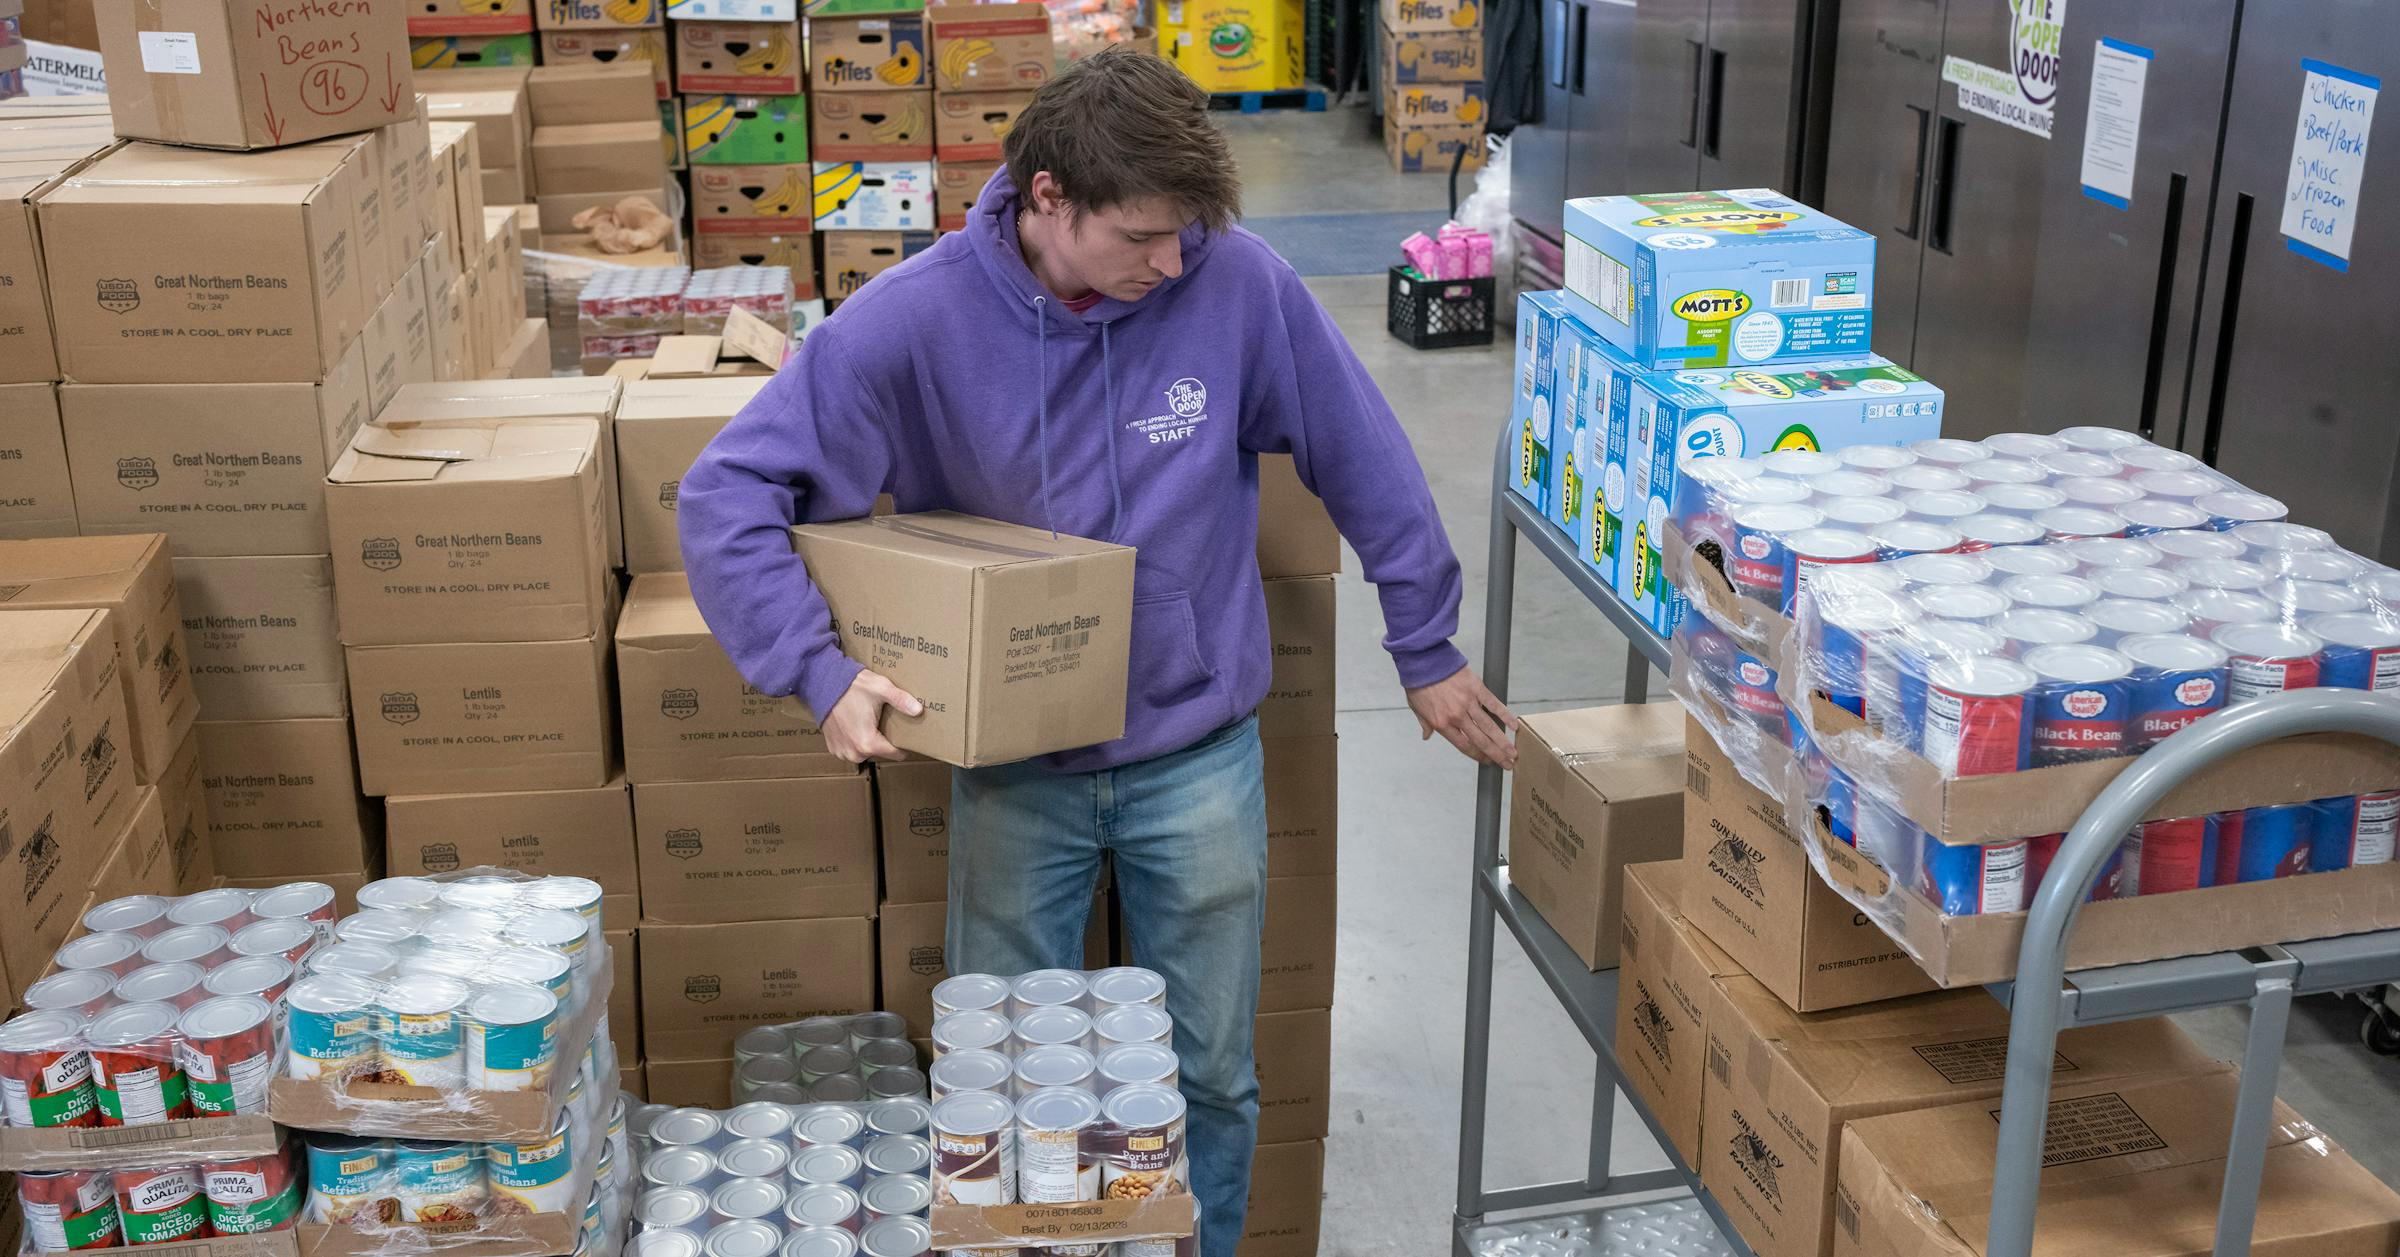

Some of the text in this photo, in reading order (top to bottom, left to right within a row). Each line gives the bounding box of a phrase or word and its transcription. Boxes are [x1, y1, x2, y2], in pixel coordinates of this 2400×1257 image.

[256, 0, 371, 38] Northern
[277, 32, 360, 65] Beans
[2021, 48, 2060, 86] DOOR
[1951, 63, 2017, 96] FRESH APPROACH
[313, 68, 346, 106] 96
[2313, 80, 2366, 116] Chicken
[1971, 92, 2001, 115] ENDING
[2002, 102, 2027, 124] LOCAL
[2305, 181, 2346, 208] Frozen
[2301, 209, 2335, 236] Food
[154, 275, 288, 289] Great Northern Beans
[101, 292, 135, 300] FOOD
[211, 302, 223, 310] 24
[1680, 296, 1744, 314] MOTT'S
[121, 329, 160, 337] STORE
[227, 328, 252, 336] DRY
[256, 328, 293, 336] PLACE
[1175, 383, 1192, 395] THE
[1181, 389, 1204, 402] OPEN
[1177, 400, 1202, 412] DOOR
[1130, 413, 1177, 428] FRESH APPROACH
[1147, 422, 1168, 431] ENDING
[1168, 419, 1187, 428] LOCAL
[1188, 414, 1208, 425] HUNGER
[1148, 425, 1196, 443] STAFF
[172, 452, 302, 466] Great Northern Beans
[139, 504, 178, 513] STORE
[180, 504, 191, 512] IN
[244, 502, 267, 511] DRY
[271, 502, 308, 511] PLACE
[1594, 490, 1604, 560] MOTT'S
[415, 532, 542, 548] Great Northern Beans
[1635, 526, 1646, 595] MOTT'S
[384, 582, 550, 594] STORE IN COOL, DRY PLACE
[205, 614, 297, 629] Northern Beans
[1009, 615, 1101, 642] Great Northern Beans
[853, 621, 949, 658] Great Northern Beans
[887, 648, 904, 660] bags
[1006, 644, 1041, 659] PO# 32547
[1278, 644, 1313, 656] Beans
[243, 663, 306, 673] DRY PLACE
[1004, 661, 1028, 673] Packed
[1046, 664, 1058, 675] ND
[2265, 665, 2284, 673] Facts
[463, 687, 501, 700] Lentils
[2181, 682, 2213, 696] American
[2067, 693, 2101, 707] American
[2183, 691, 2208, 704] Beauty
[2070, 703, 2098, 716] Beauty
[2143, 717, 2189, 732] Black
[403, 733, 564, 746] STORE IN DRY PLACE
[680, 733, 715, 741] STORE
[2035, 727, 2122, 741] Black Beans
[1688, 750, 1711, 772] 24/15 OZ
[225, 774, 314, 788] Northern Beans
[1762, 803, 1775, 819] 22.5
[744, 822, 781, 835] Lentils
[501, 835, 540, 848] Lentils
[1568, 824, 1585, 849] Beans
[1710, 818, 1766, 864] SUN VALLEY
[1987, 849, 2014, 857] Nutrition
[685, 872, 720, 880] STORE
[1711, 896, 1742, 925] PRODUCT OF
[1818, 954, 1890, 973] DISTRIBUTED BY
[762, 968, 797, 981] Lentils
[1636, 979, 1651, 1002] SUN
[1649, 999, 1674, 1033] VALLEY
[1711, 1033, 1732, 1061] 24/15 OZ
[1731, 1109, 1785, 1169] SUN VALLEY
[1781, 1111, 1818, 1154] 22.5 NET
[1130, 1137, 1163, 1149] FINEST
[2113, 1137, 2160, 1152] STORAGE
[1123, 1149, 1170, 1162] Pork and
[343, 1157, 377, 1173] FINEST
[1130, 1159, 1163, 1169] Beans
[147, 1176, 183, 1194] PRIMA
[212, 1176, 248, 1187] PRIMA
[502, 1176, 537, 1187] Beans
[142, 1184, 189, 1206] QUALITA
[210, 1184, 253, 1195] QUALITA
[322, 1183, 366, 1196] Refried
[1838, 1179, 1861, 1214] 24/15 OZ
[1733, 1186, 1762, 1224] PRODUCT OF
[152, 1213, 193, 1232] DICED
[161, 1211, 181, 1221] ADDED
[218, 1213, 255, 1224] DICED
[139, 1215, 205, 1242] TOMATOES
[1022, 1224, 1061, 1236] Best By
